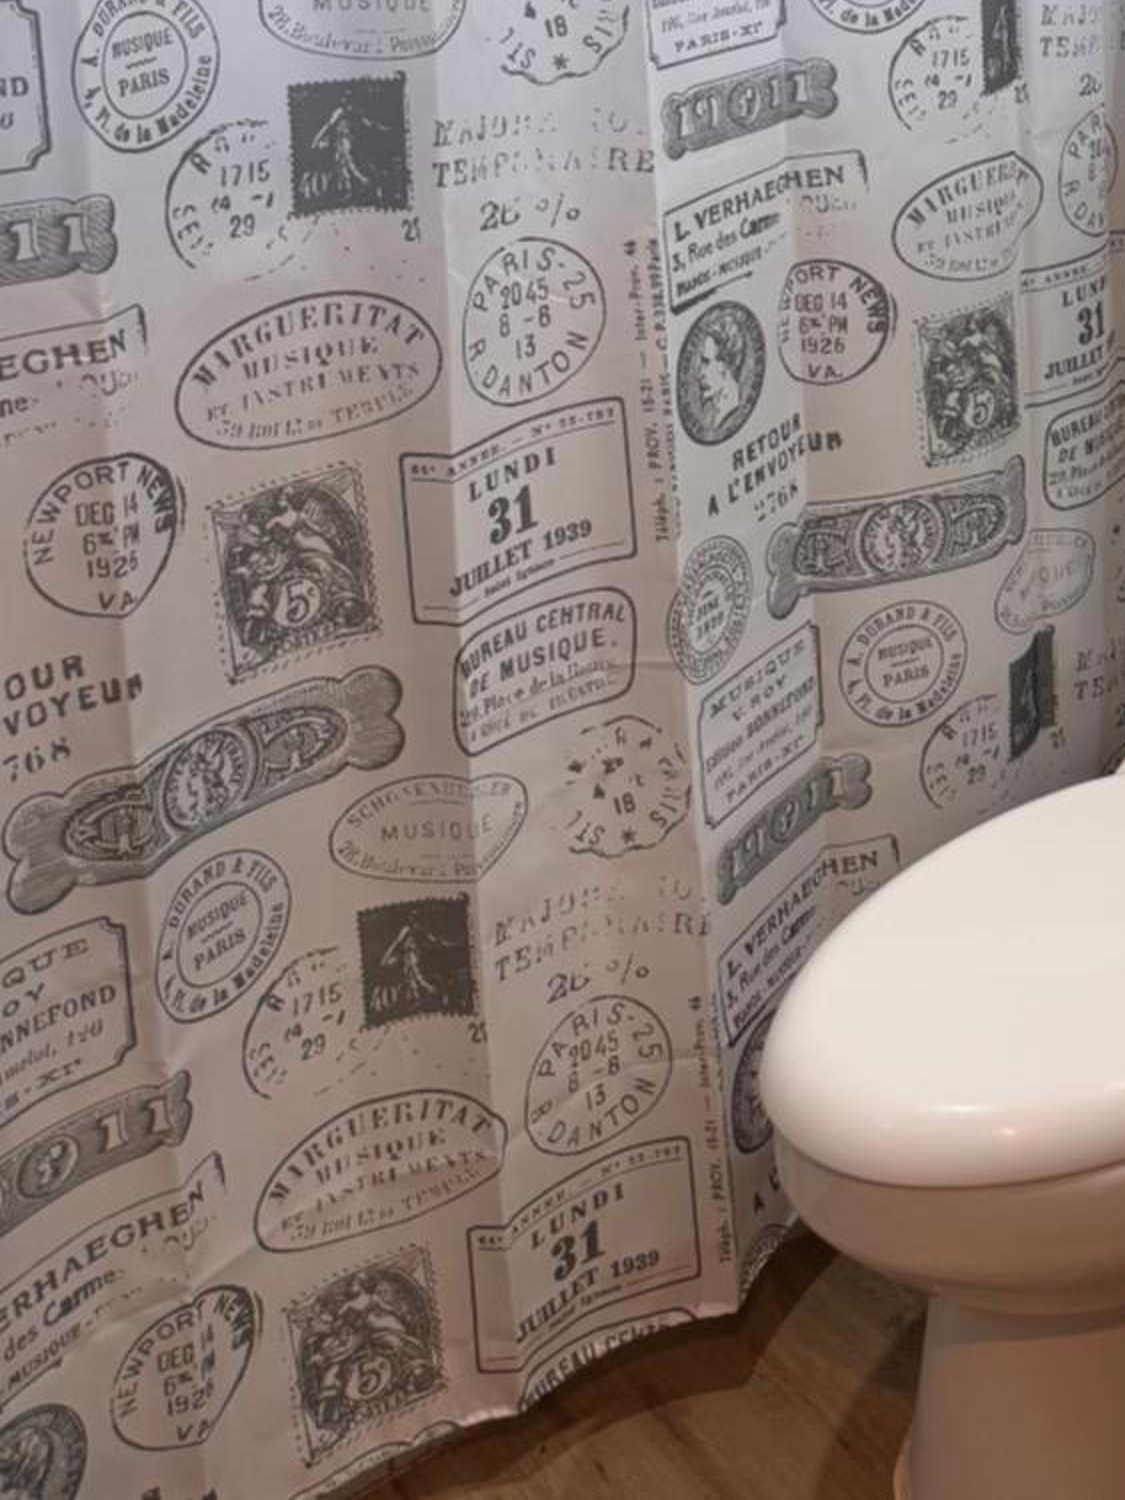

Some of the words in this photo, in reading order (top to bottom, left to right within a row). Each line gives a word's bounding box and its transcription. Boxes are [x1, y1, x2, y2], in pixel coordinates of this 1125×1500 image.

[111, 27, 173, 57] MUSIQUE
[171, 0, 205, 40] FILS
[544, 15, 569, 38] 18
[117, 68, 172, 98] PARIS
[693, 164, 846, 229] VERHAEGHEN
[229, 214, 256, 239] 29
[830, 290, 850, 311] 14
[1077, 304, 1106, 347] 31
[242, 335, 381, 381] MUSIQUE
[482, 330, 589, 398] DANTON
[515, 332, 537, 360] 13
[800, 336, 846, 355] 1926
[732, 412, 802, 473] RETOUR
[466, 445, 556, 503] LUNDI
[706, 494, 720, 518] A
[726, 430, 843, 506] L'ENVOYEUR
[31, 458, 132, 567] NEWPORT
[136, 464, 176, 535] NEWS
[487, 483, 539, 546] 31
[448, 540, 533, 598] JUILLET
[541, 518, 593, 552] 1939
[461, 621, 527, 677] BUREAU
[535, 600, 626, 634] CENTRAL
[882, 664, 931, 690] PARIS
[380, 811, 492, 842] MUSIQUE
[612, 792, 636, 815] 18
[167, 860, 227, 930] DURAND
[246, 862, 278, 894] FILS
[185, 889, 250, 941] MUSIQUE
[192, 926, 247, 973] PARIS
[301, 1034, 327, 1062] 29
[538, 1001, 626, 1079] PARIS
[547, 1076, 657, 1149] DANTON
[527, 1182, 625, 1251] LUNDI
[550, 1219, 606, 1282] 31
[514, 1267, 601, 1345] JUILLET
[609, 1250, 662, 1281] 1939
[115, 1301, 205, 1418] NEWPORT
